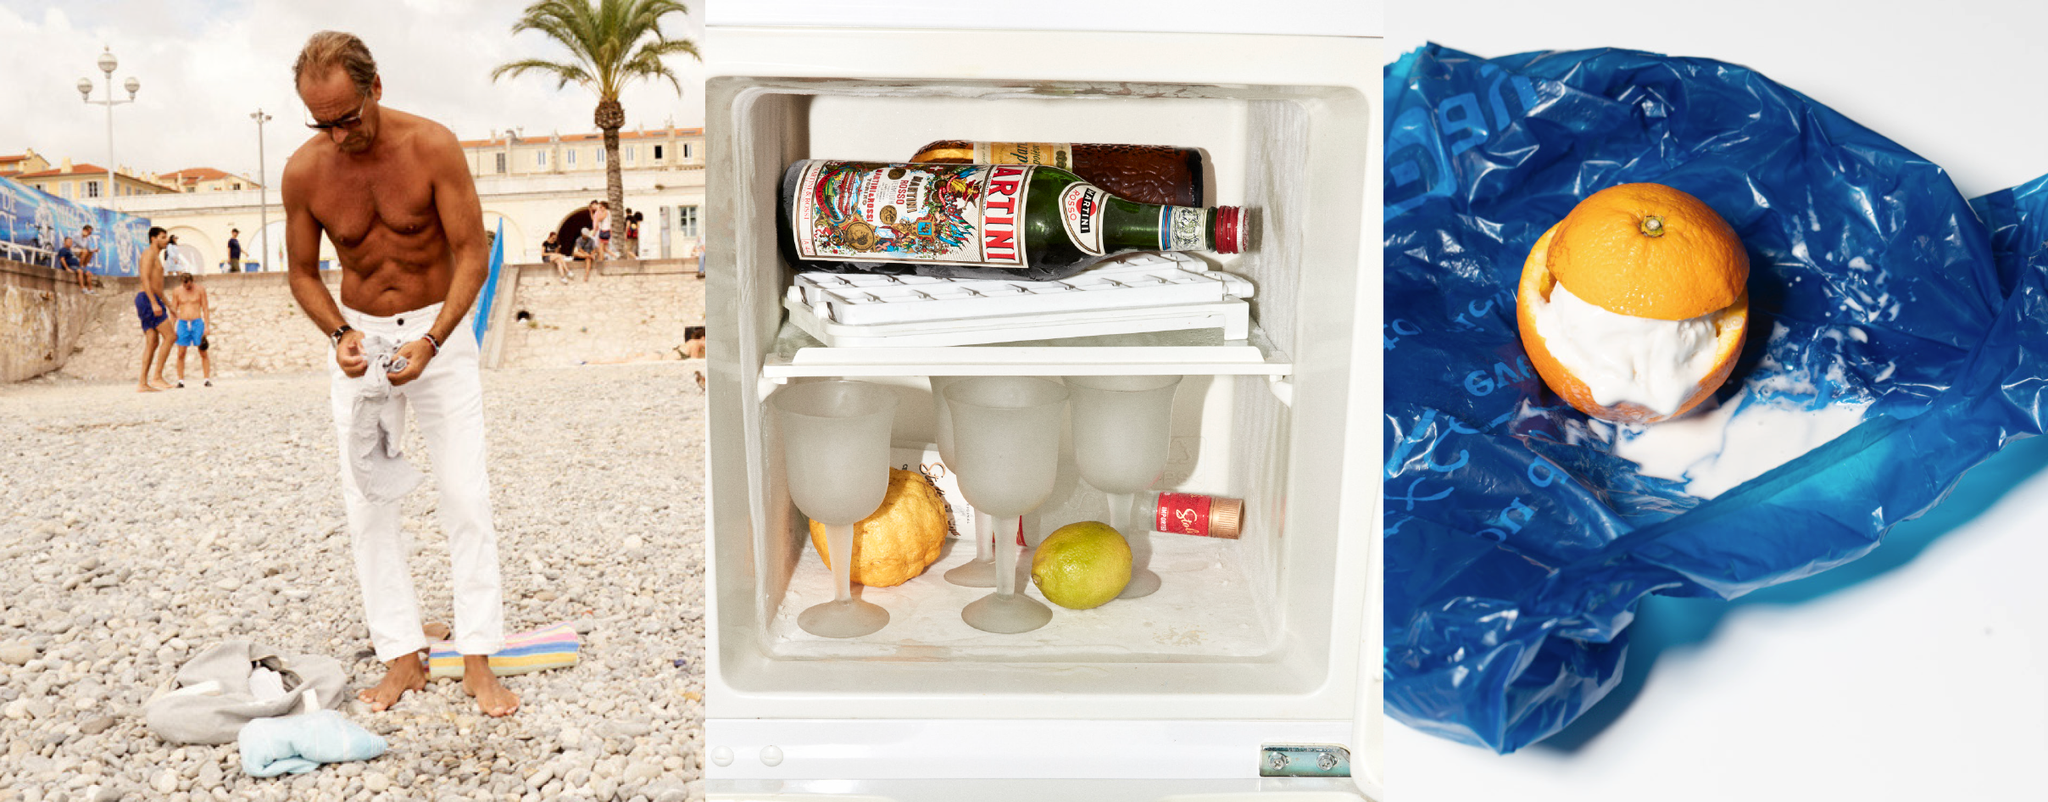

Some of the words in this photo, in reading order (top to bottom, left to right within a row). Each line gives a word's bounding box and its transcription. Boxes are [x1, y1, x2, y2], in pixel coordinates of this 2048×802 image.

[895, 179, 909, 205] ROSSO
[906, 175, 924, 213] MARTINI
[1067, 189, 1081, 221] ROSSO
[1080, 188, 1096, 231] MARTINI
[984, 165, 1024, 260] ARTINI
